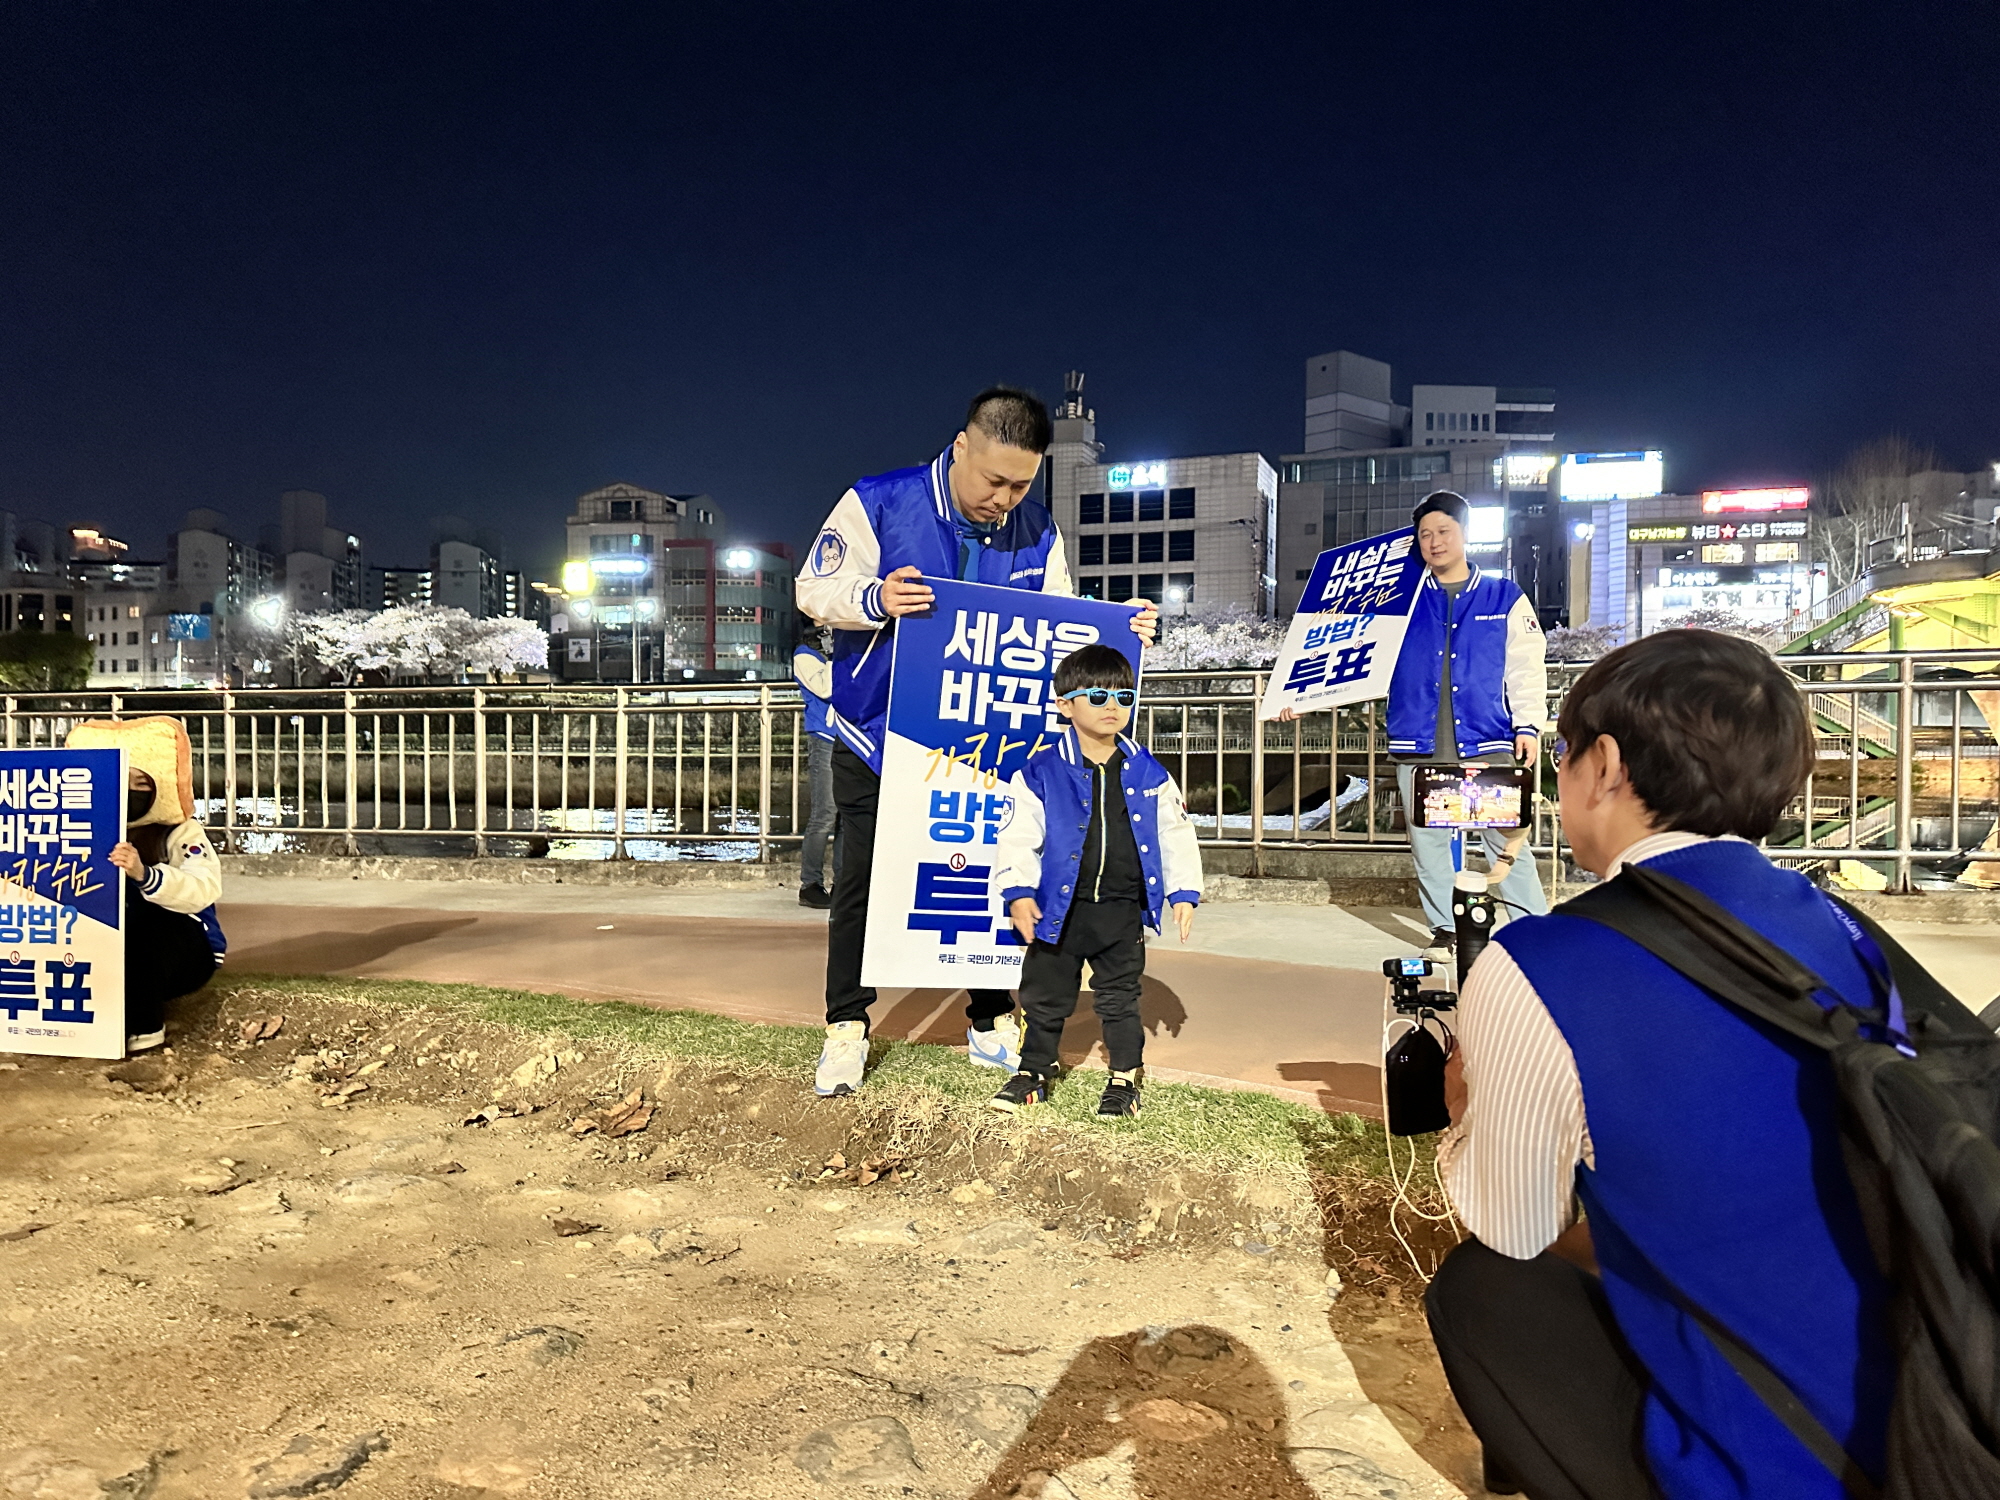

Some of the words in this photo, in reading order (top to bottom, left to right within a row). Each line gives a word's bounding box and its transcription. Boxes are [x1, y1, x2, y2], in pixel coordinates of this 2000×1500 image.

[1691, 525, 1719, 539] 뷰티
[1737, 523, 1767, 538] 스타
[1321, 563, 1404, 601] 바꾸는
[1307, 594, 1362, 627] 가장
[944, 609, 1100, 673] 세상을
[1303, 613, 1375, 650] 방법?
[1283, 641, 1377, 694] 투표
[924, 732, 1027, 790] 가장
[0, 768, 93, 809] 세상을
[0, 814, 93, 855] 바꾸는
[51, 850, 104, 901] 쉬운
[0, 904, 78, 945] 방법?
[907, 862, 1029, 946] 투
[938, 953, 964, 964] 투표는
[967, 954, 993, 965] 국민의
[995, 955, 1021, 966] 기본권
[0, 959, 95, 1024] 투표
